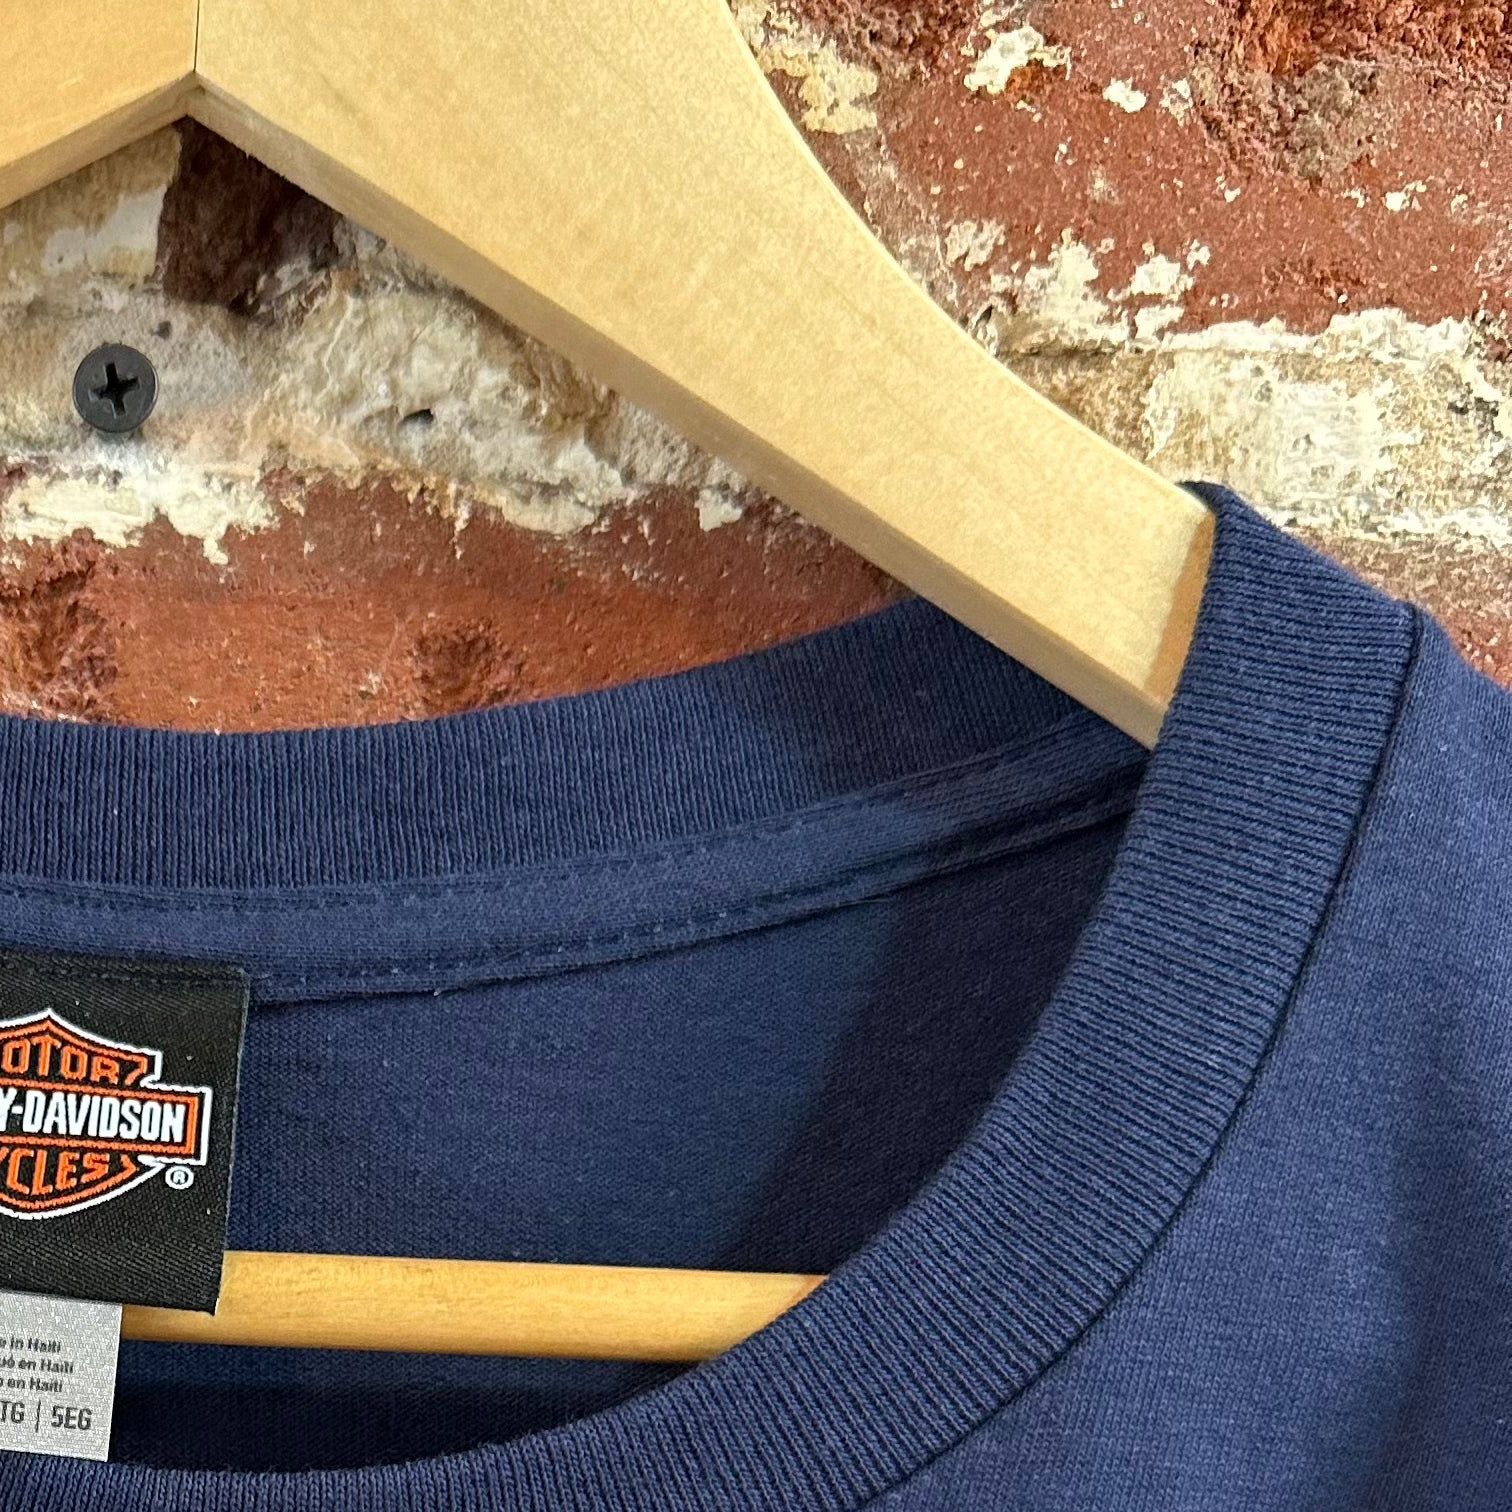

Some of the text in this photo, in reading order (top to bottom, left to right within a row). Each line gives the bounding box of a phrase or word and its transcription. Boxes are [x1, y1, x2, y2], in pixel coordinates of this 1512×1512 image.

[10, 1335, 25, 1350] in
[18, 1359, 37, 1372] en
[7, 1377, 25, 1390] en
[50, 1404, 93, 1431] 5EG
